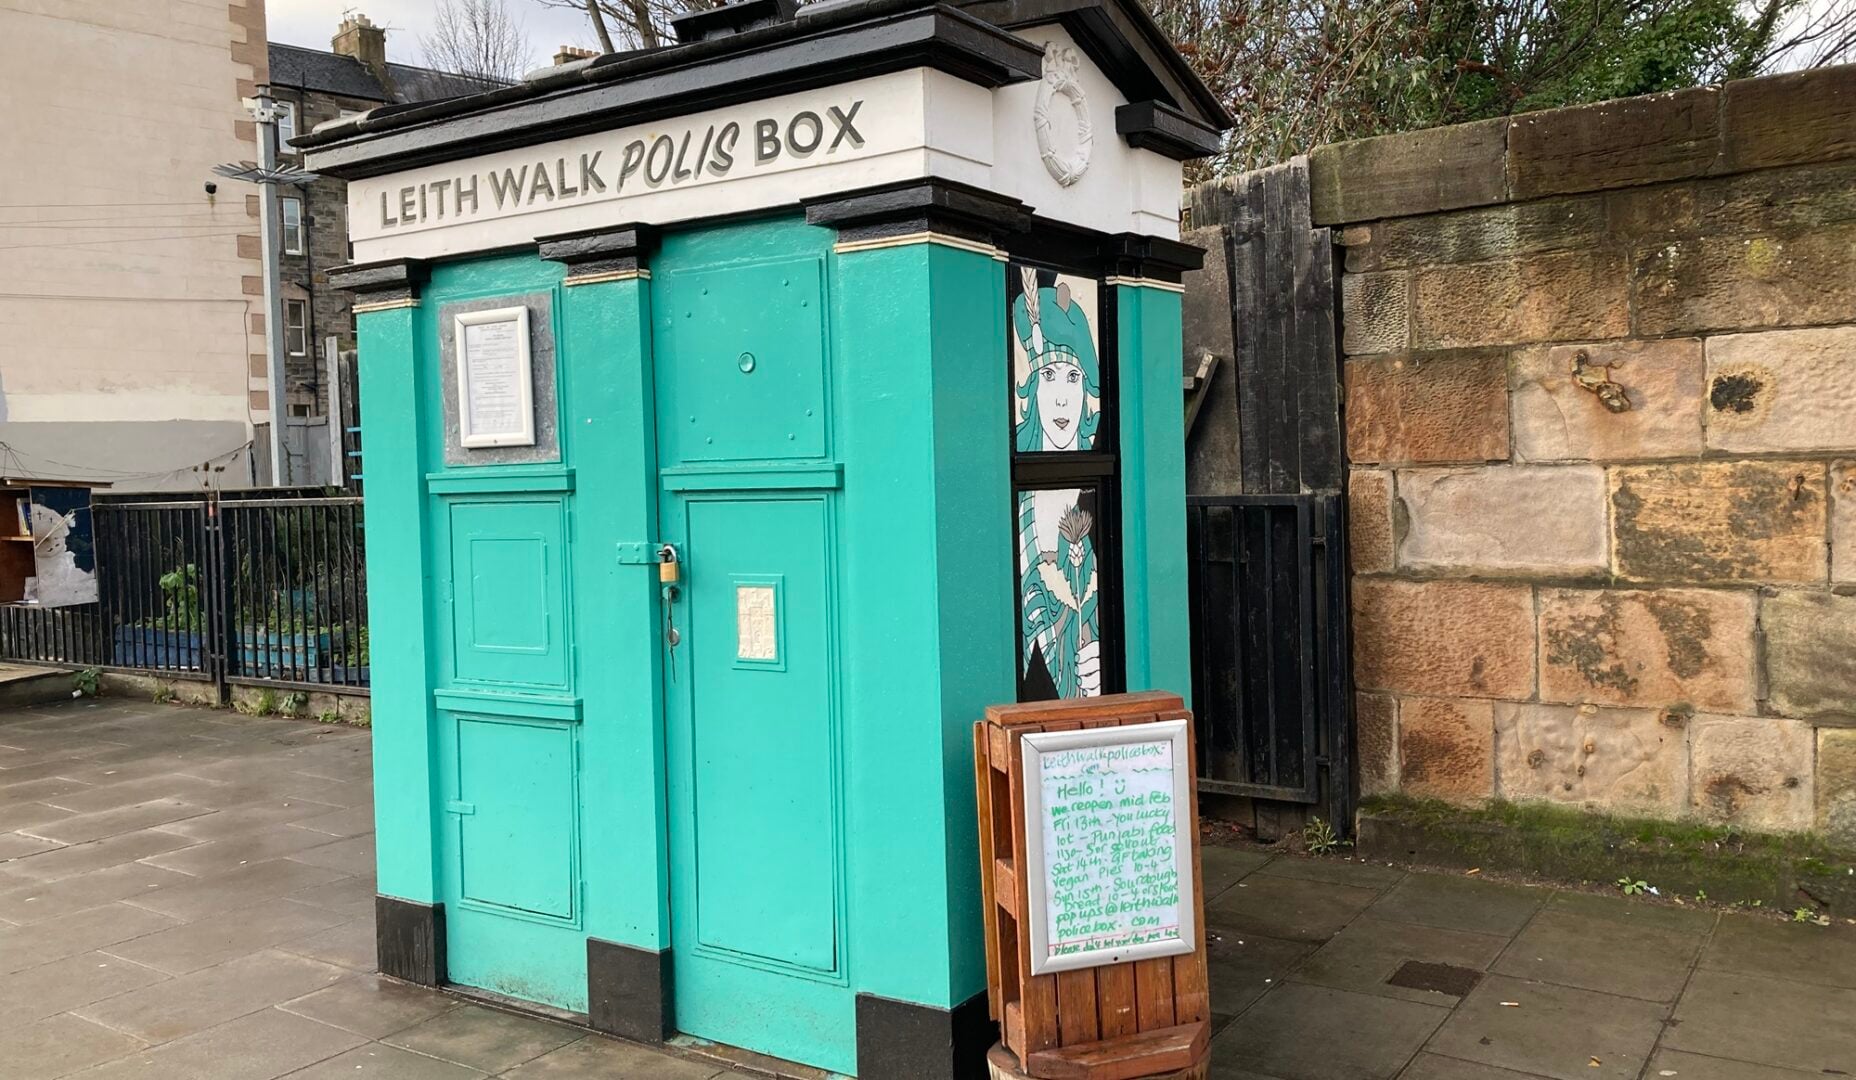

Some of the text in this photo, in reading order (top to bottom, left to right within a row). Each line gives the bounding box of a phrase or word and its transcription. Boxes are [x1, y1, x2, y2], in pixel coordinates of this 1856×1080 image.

[380, 100, 866, 229] LEITH WALK POLIS BOX
[1057, 781, 1093, 800] Hello
[1071, 800, 1113, 813] reopen
[1120, 793, 1144, 807] mid
[1149, 791, 1171, 804] Feb
[1053, 816, 1070, 831] Fri
[1075, 815, 1101, 831] 13th
[1136, 808, 1170, 826] lucky
[1056, 832, 1075, 847] lot
[1091, 826, 1144, 845] Punjabi
[1051, 862, 1074, 877] Sat
[1053, 890, 1074, 907] Sun
[1078, 884, 1102, 901] 15th
[1113, 868, 1178, 892] Sourdough
[1064, 893, 1099, 913] bread
